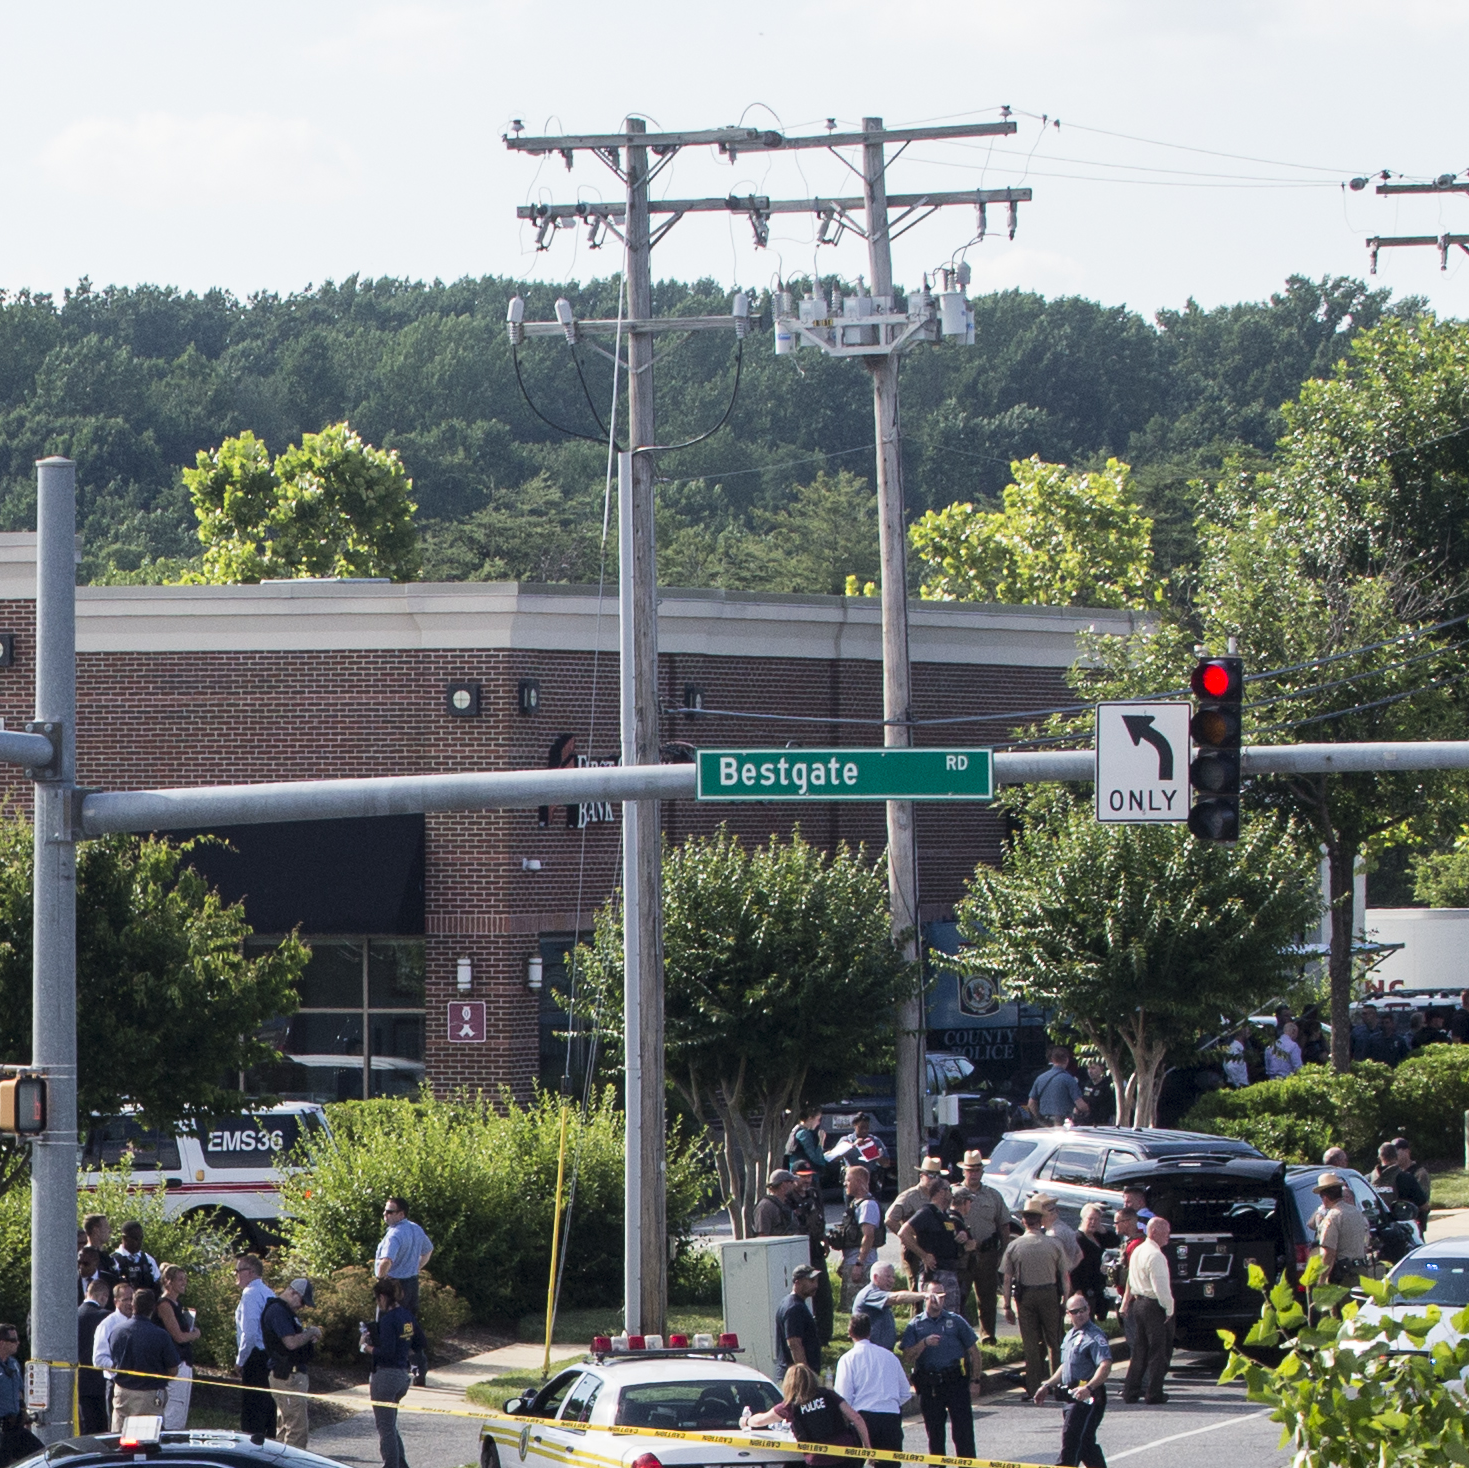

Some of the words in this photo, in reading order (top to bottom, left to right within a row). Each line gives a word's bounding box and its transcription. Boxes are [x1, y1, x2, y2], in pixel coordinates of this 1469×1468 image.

[720, 757, 859, 794] Bestgate
[945, 754, 969, 771] RD
[1110, 790, 1177, 812] ONLY
[578, 801, 614, 829] BANK
[944, 1030, 1018, 1045] COUNTY
[951, 1045, 1015, 1060] POLICE
[208, 1129, 284, 1152] EMS36
[800, 1397, 826, 1415] POLICE
